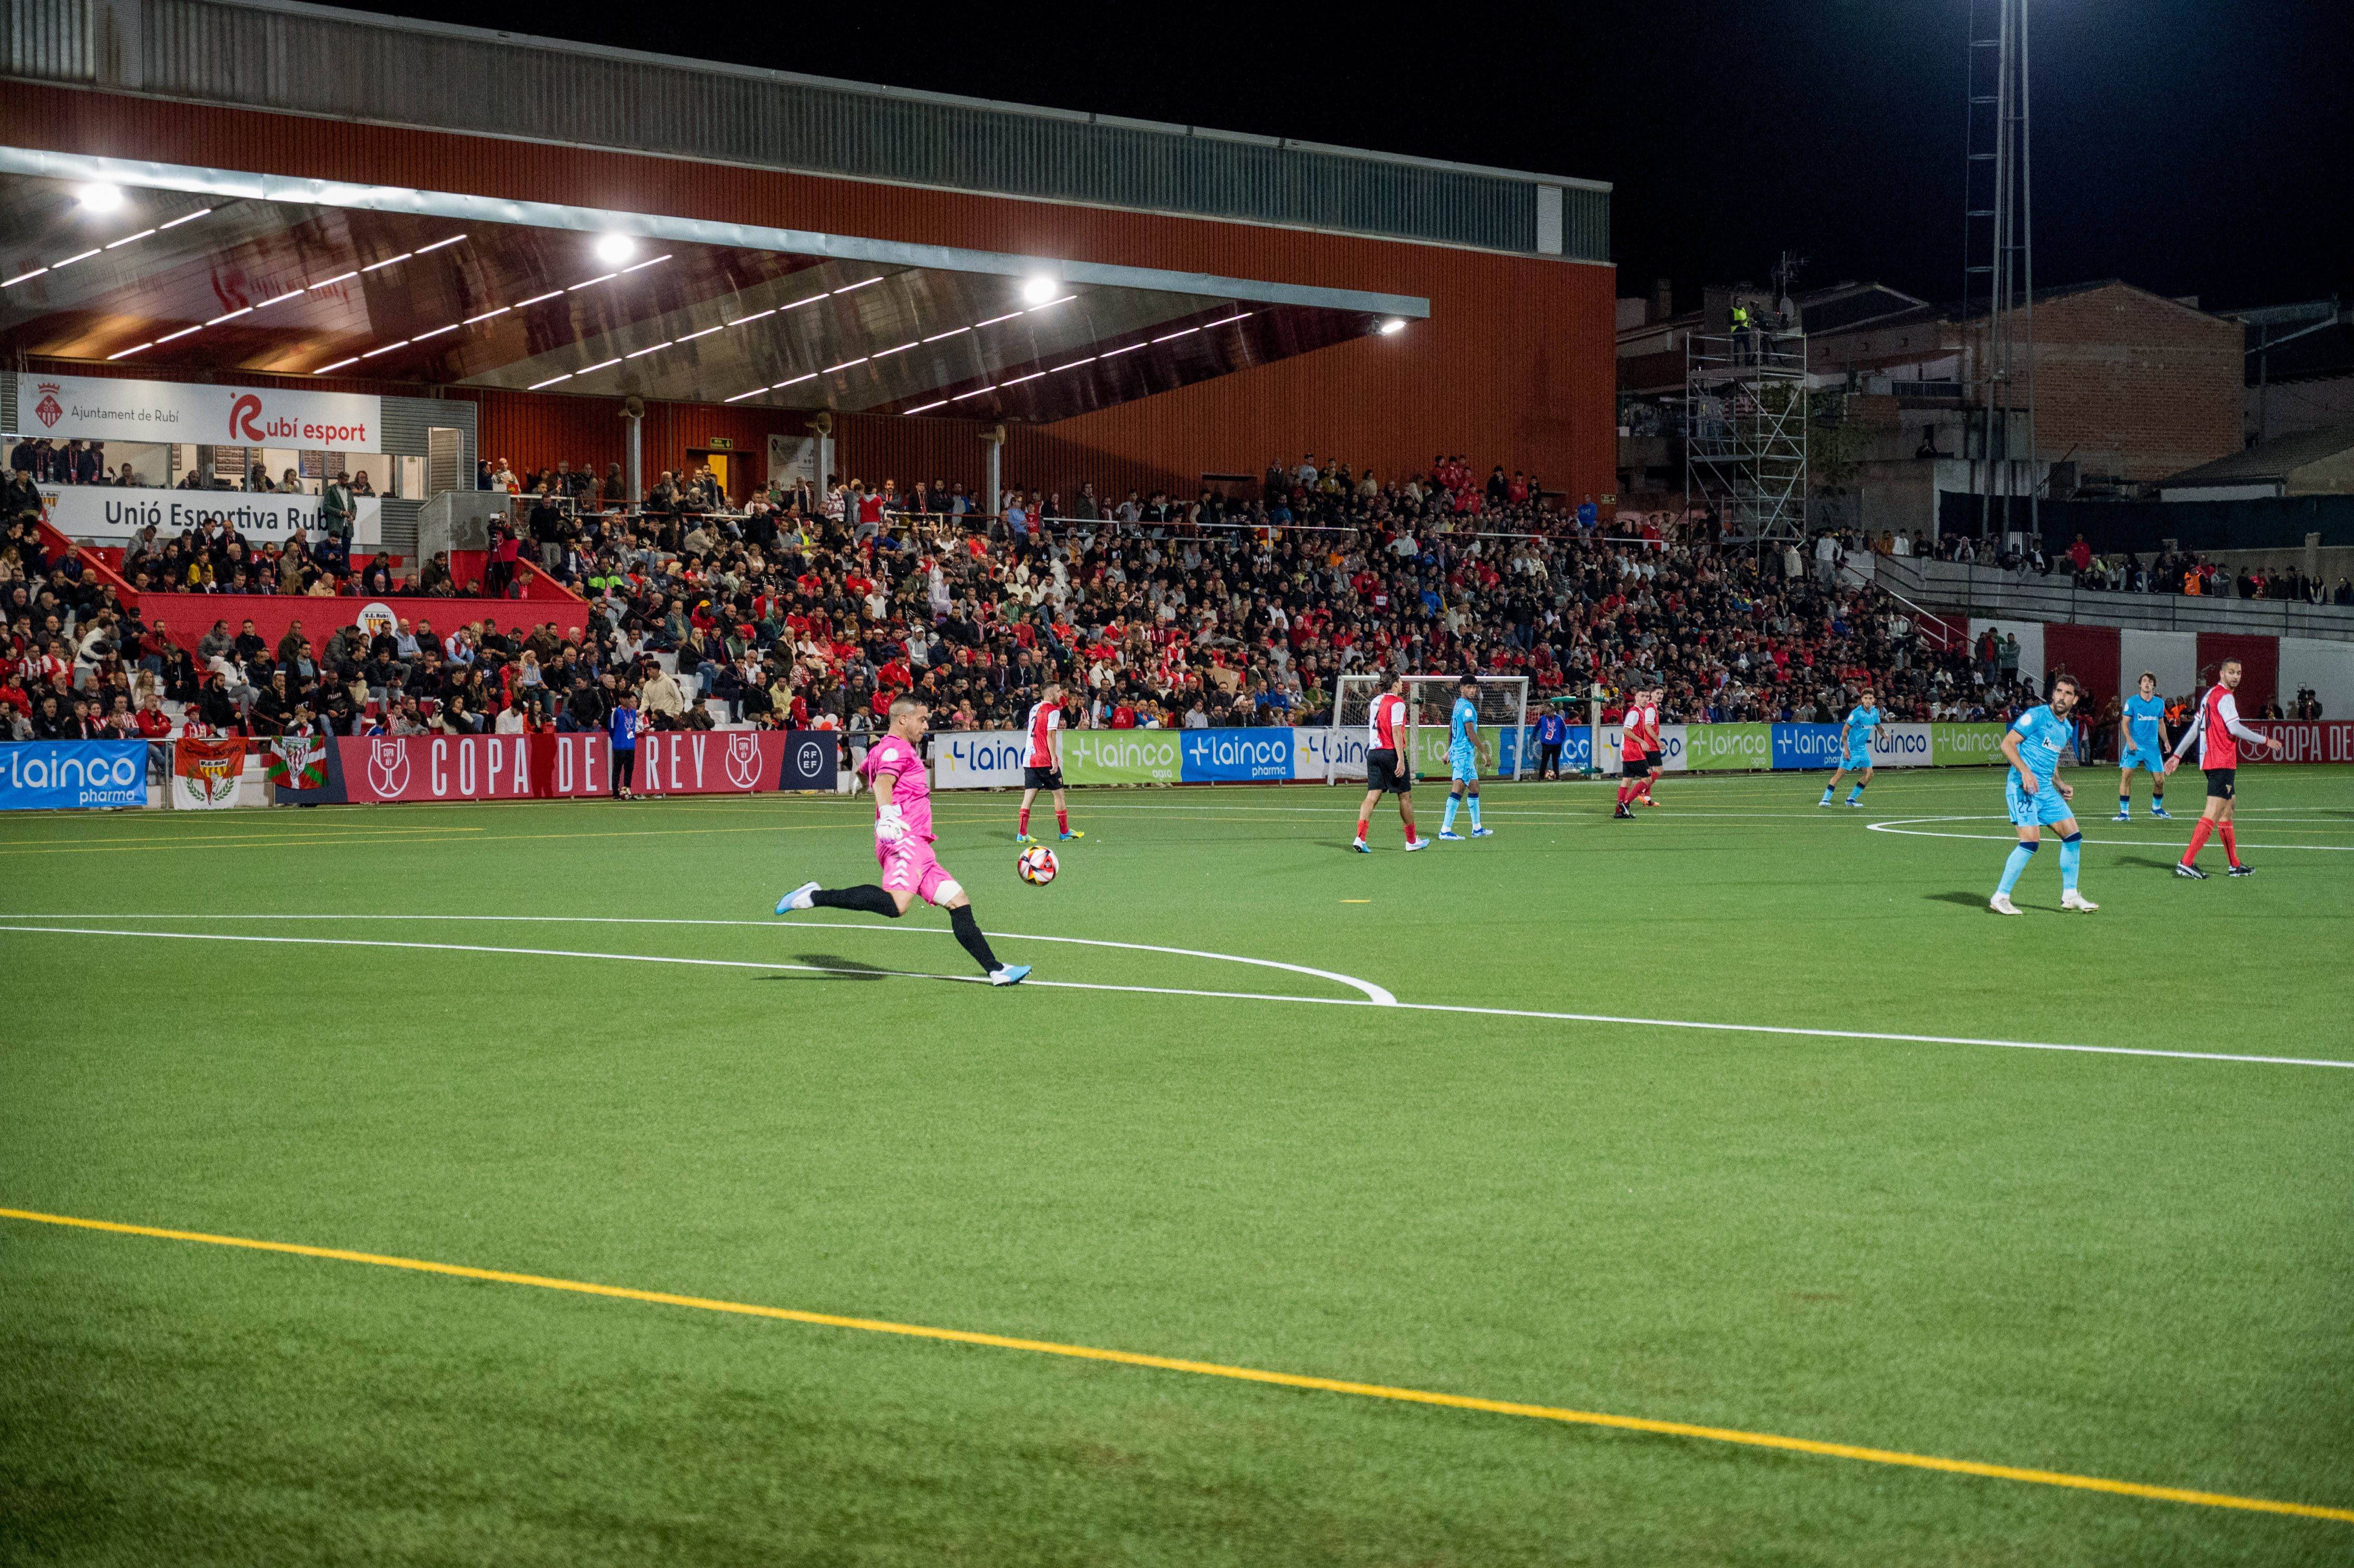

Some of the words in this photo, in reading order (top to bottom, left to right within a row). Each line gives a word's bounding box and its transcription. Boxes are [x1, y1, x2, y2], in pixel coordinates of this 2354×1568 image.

[71, 406, 135, 421] Ajuntament
[138, 408, 152, 421] de
[155, 410, 179, 423] Rubí
[229, 393, 298, 442] Rubí
[303, 424, 365, 445] esport
[106, 501, 161, 526] Unió
[171, 503, 278, 530] Esportiva
[287, 508, 329, 531] Rub
[1095, 737, 1174, 767] lainco
[1212, 736, 1286, 765] lainco
[1709, 729, 1766, 755] lainco
[1952, 728, 2002, 752] lainco
[2272, 726, 2322, 761] COPA
[2330, 726, 2354, 761] DE
[12, 750, 136, 788] lainco
[431, 738, 529, 796] COPA
[646, 735, 705, 790] REY
[970, 740, 1027, 770] lain
[1152, 769, 1172, 780] agro
[1252, 766, 1286, 778] pharma
[80, 789, 135, 805] pharma
[2018, 800, 2033, 813] 22
